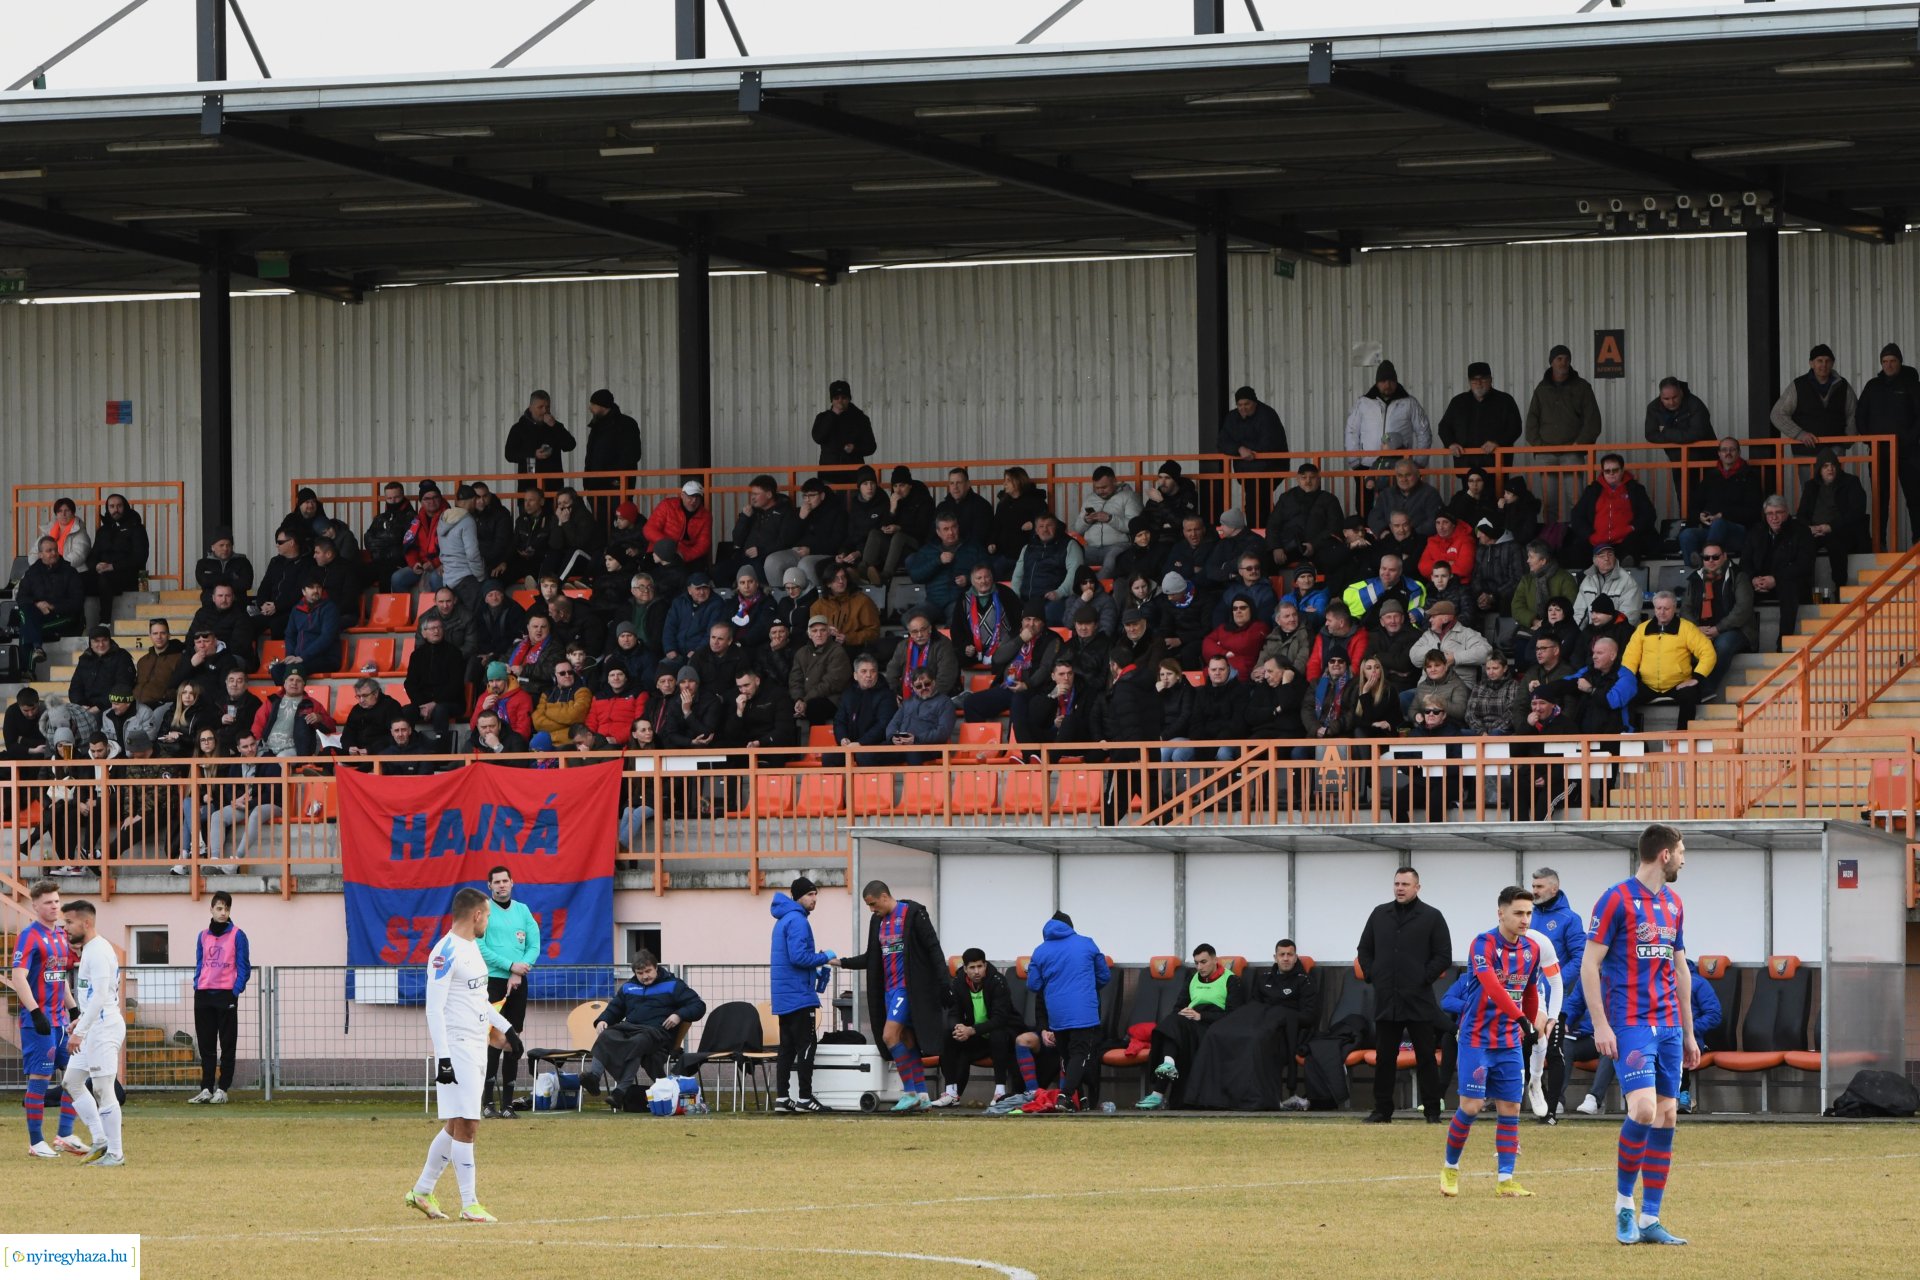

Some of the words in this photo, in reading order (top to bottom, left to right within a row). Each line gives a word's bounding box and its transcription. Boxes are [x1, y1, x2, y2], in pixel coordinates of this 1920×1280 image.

[1597, 336, 1622, 363] A
[136, 638, 142, 648] 5
[1318, 745, 1345, 775] A
[389, 792, 559, 860] HAJRÁ
[896, 998, 904, 1008] 7
